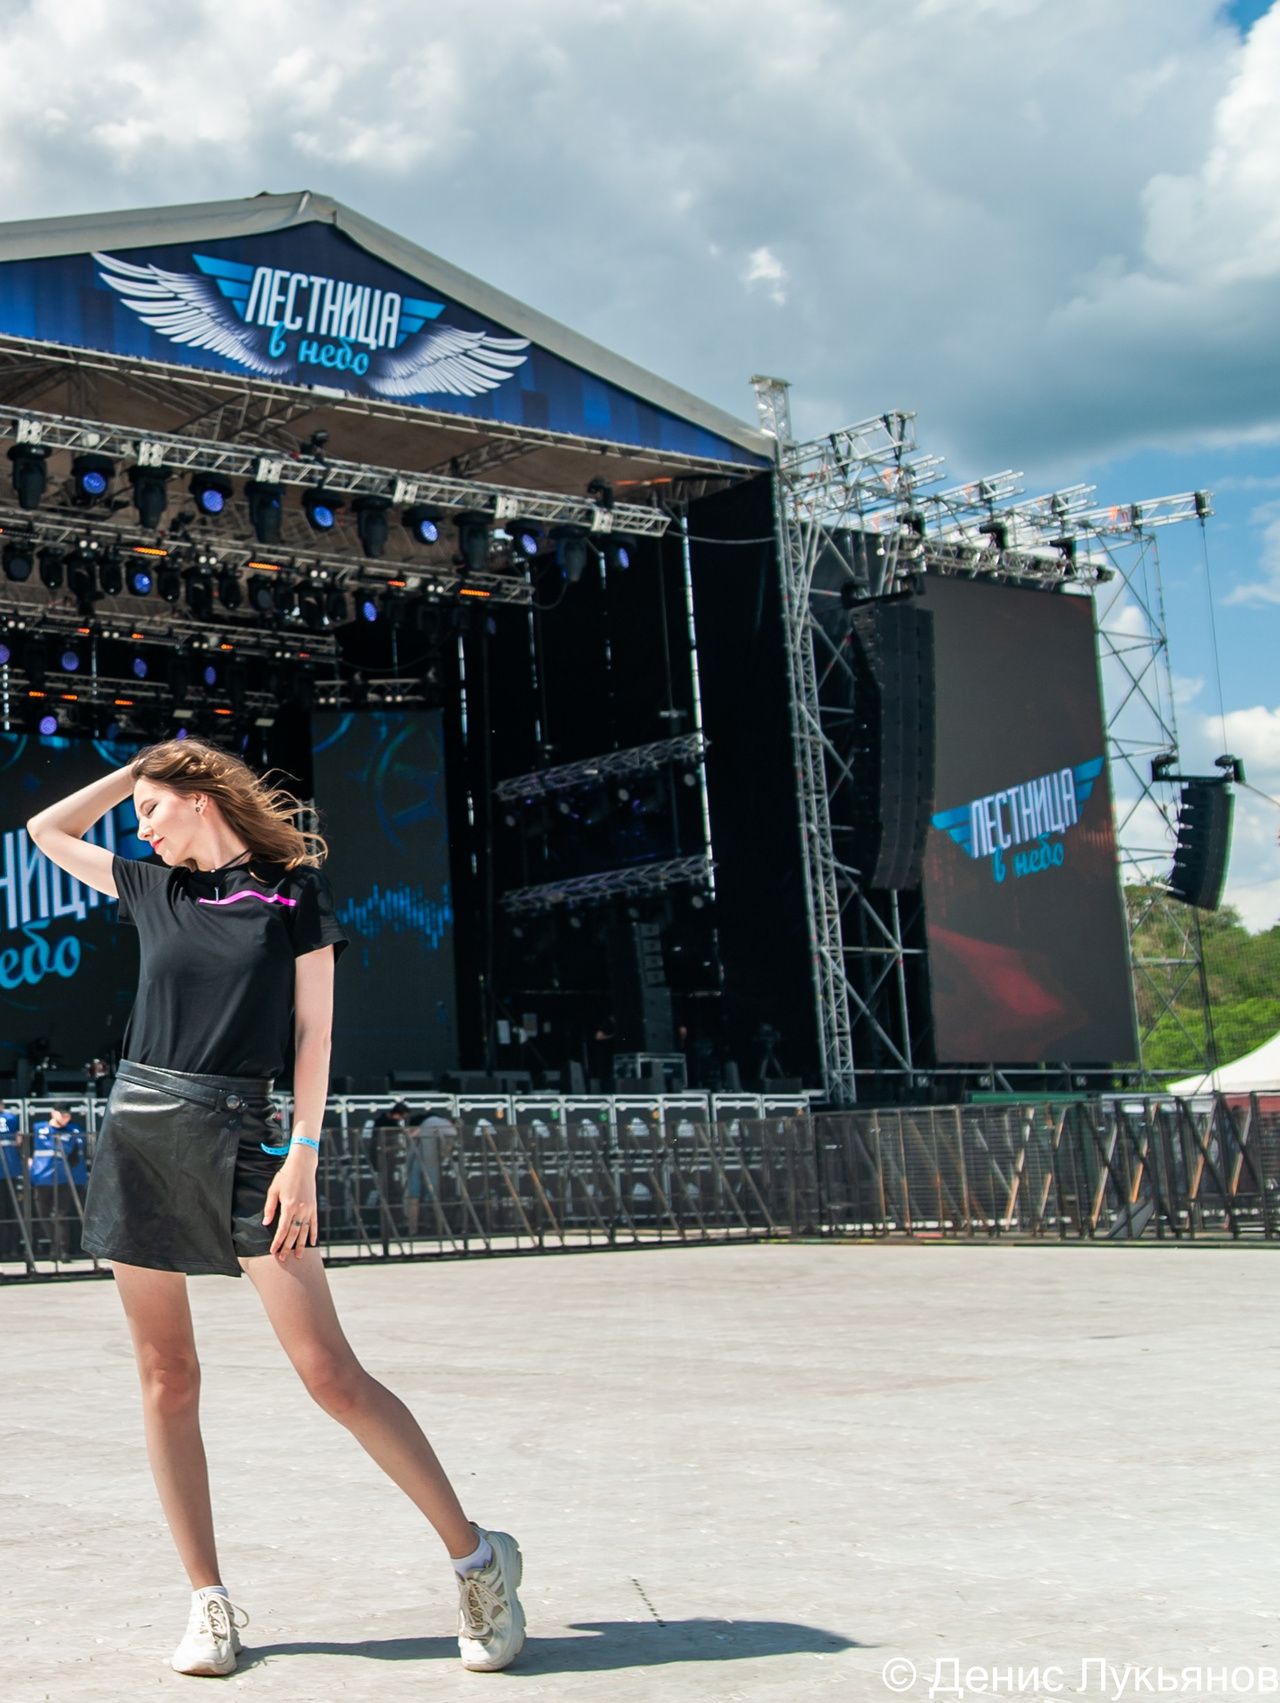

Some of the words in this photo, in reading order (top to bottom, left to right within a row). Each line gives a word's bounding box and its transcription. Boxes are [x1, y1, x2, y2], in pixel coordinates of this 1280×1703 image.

[245, 267, 401, 349] ЛЕСТНИЦА
[269, 323, 286, 357] в
[299, 325, 370, 376] небо
[971, 768, 1078, 858] ЛЕСТНИЦА
[993, 846, 1006, 883] в
[1014, 833, 1064, 876] небо
